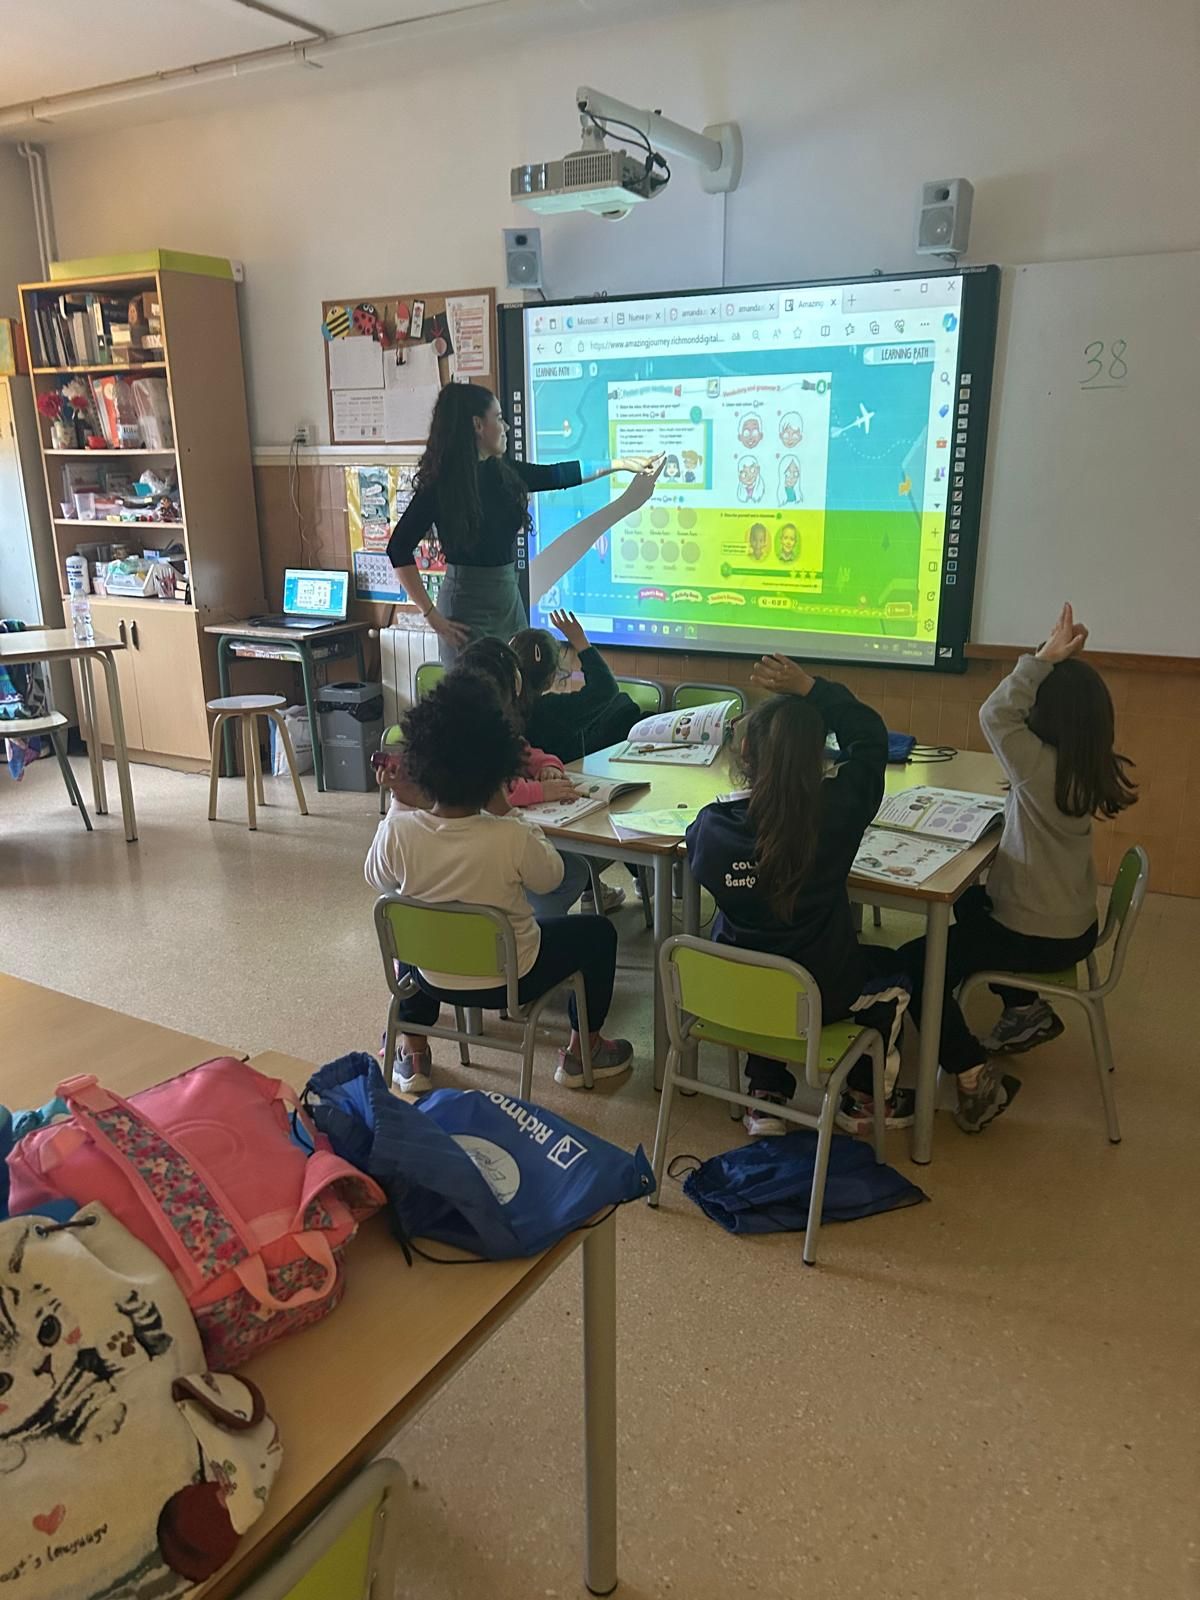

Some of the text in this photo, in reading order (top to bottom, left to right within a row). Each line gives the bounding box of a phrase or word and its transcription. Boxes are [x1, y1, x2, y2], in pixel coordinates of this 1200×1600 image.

[881, 347, 929, 360] LEARNING PATH
[1079, 339, 1127, 384] 38
[535, 366, 570, 378] LEARNING PATH
[466, 1089, 554, 1145] Richmo
